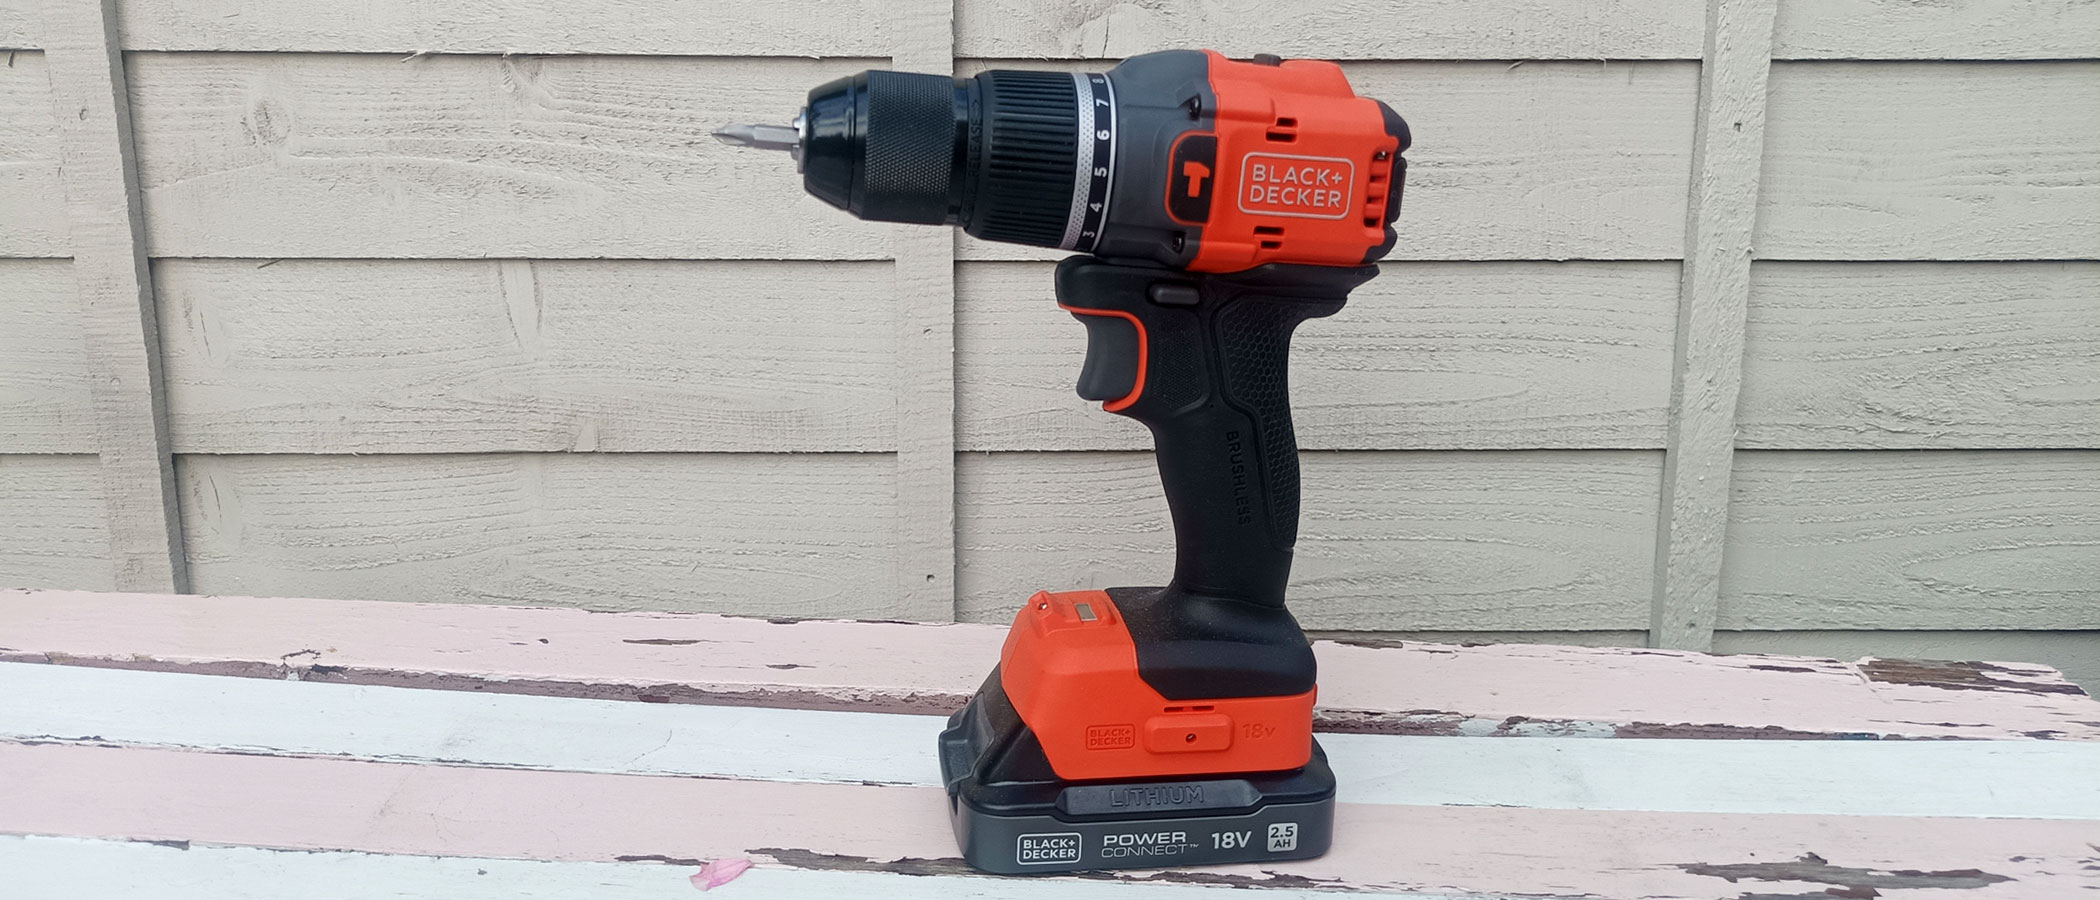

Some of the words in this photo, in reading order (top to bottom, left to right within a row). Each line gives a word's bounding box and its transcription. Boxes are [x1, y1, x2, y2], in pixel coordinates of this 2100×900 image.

[1092, 77, 1105, 85] 8
[1095, 98, 1109, 107] 7
[1096, 129, 1110, 141] 6
[1094, 167, 1108, 178] 5
[1252, 164, 1343, 187] BLACK+
[1250, 184, 1342, 208] DECKER
[1089, 202, 1102, 213] 4
[1082, 230, 1095, 239] 3
[1226, 430, 1252, 525] BRUSHLESS
[1090, 727, 1131, 738] BLACK+
[1090, 736, 1131, 746] DECKER
[1110, 785, 1204, 807] LITHIUM
[1270, 825, 1294, 839] 2.5
[1023, 838, 1076, 849] BLACK+
[1103, 831, 1187, 846] POWER
[1211, 831, 1252, 849] 18V
[1273, 838, 1291, 849] AH
[1023, 848, 1076, 860] DECKER
